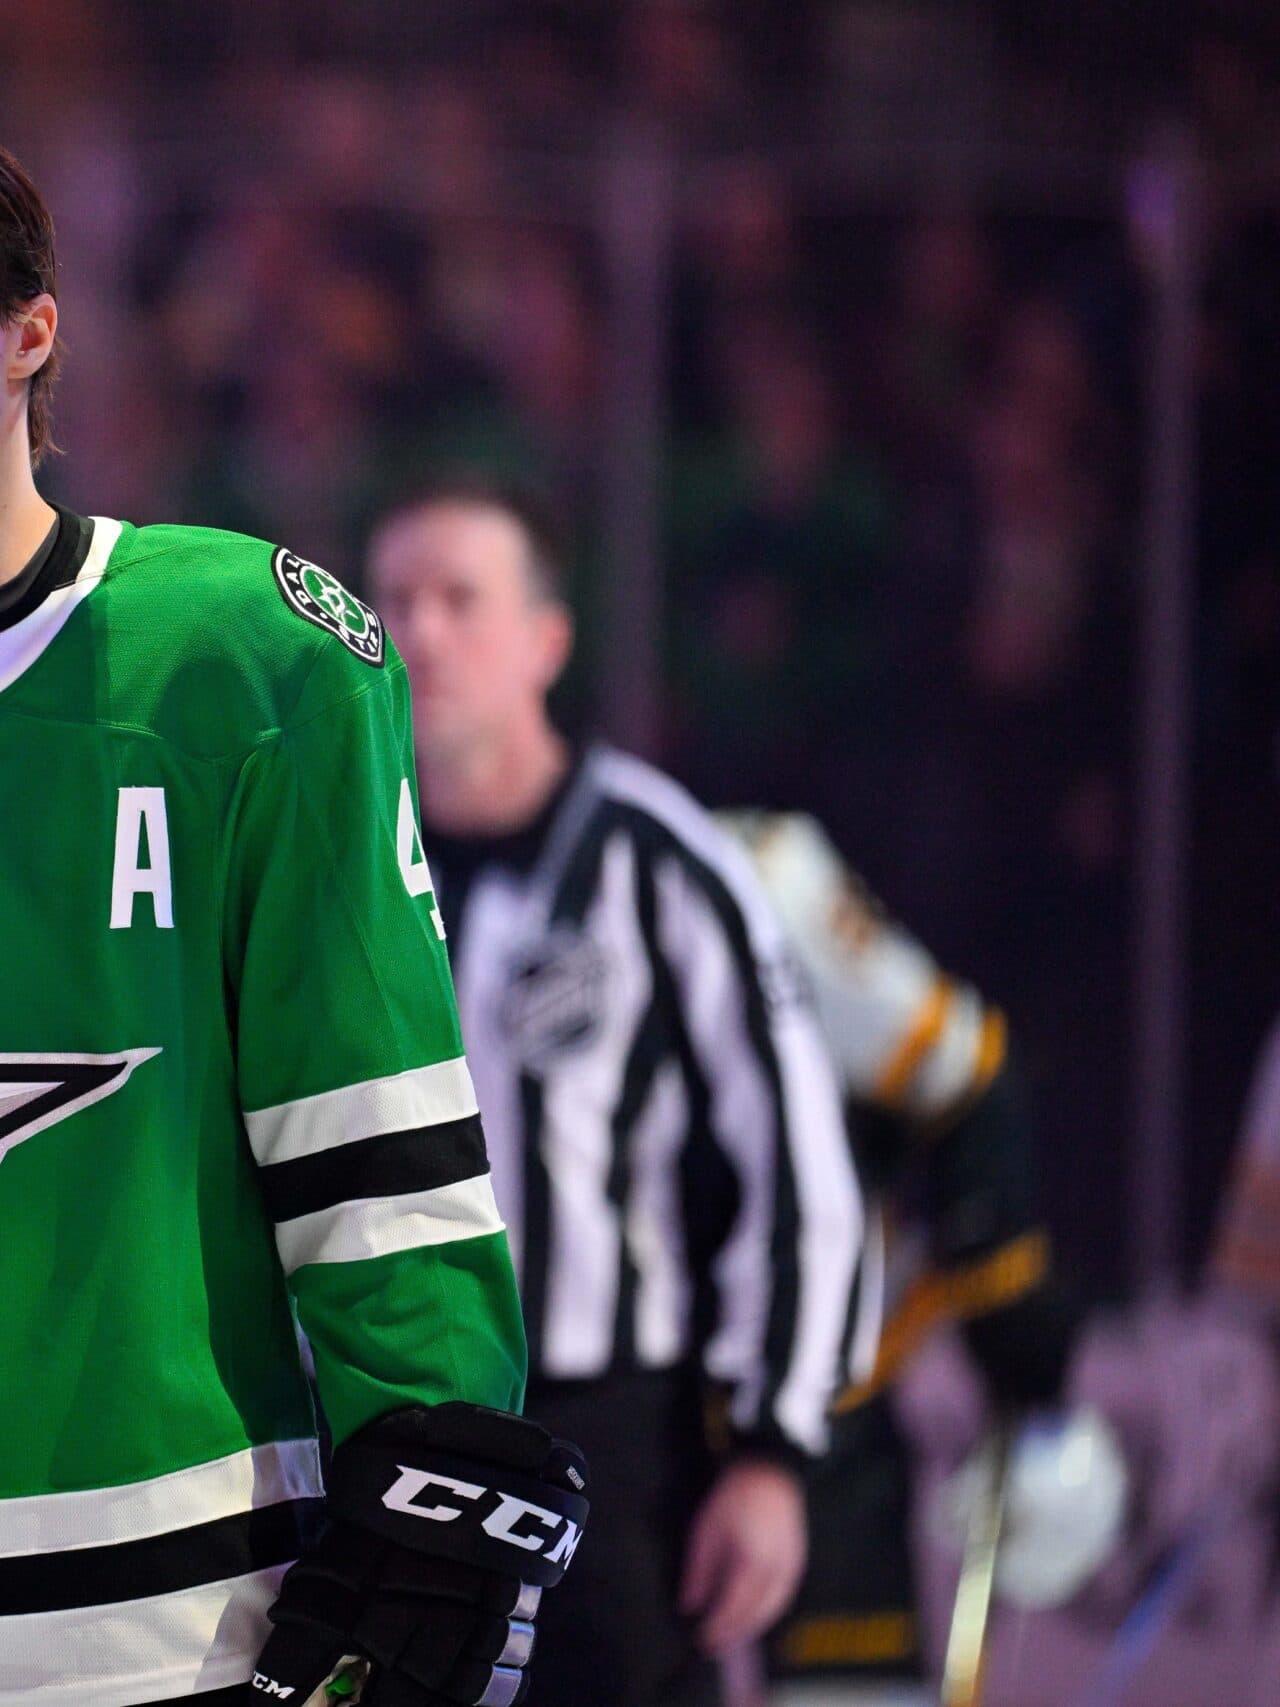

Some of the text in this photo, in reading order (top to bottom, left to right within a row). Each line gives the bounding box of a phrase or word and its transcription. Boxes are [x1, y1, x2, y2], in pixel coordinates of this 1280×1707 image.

[286, 558, 312, 605] DAL
[111, 786, 174, 929] A
[382, 1464, 583, 1570] CCM
[253, 1671, 296, 1699] CM
